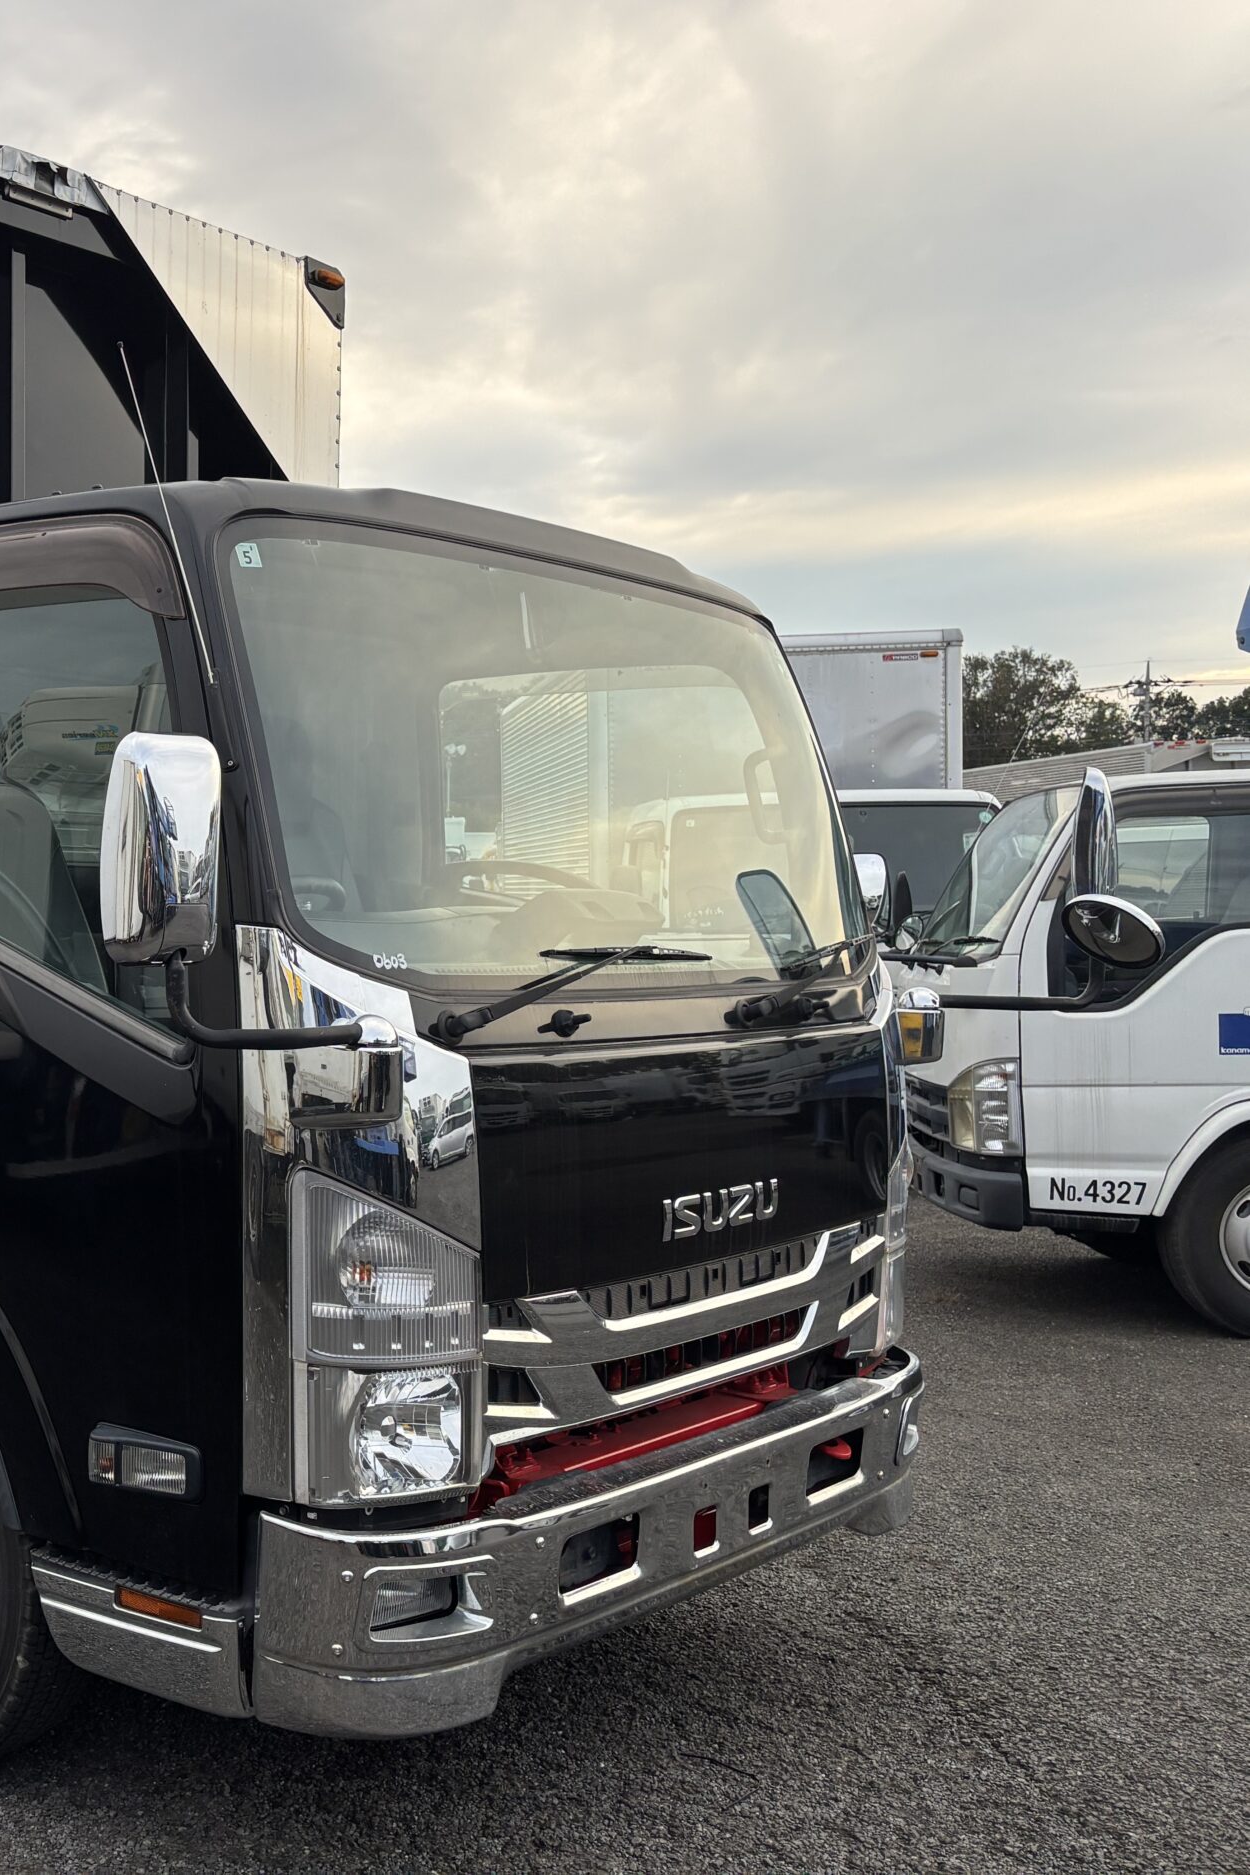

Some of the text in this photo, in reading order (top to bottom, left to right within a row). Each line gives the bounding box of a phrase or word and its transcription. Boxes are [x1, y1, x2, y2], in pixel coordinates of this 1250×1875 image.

[372, 951, 408, 970] 0603
[1049, 1177, 1147, 1206] No.4327
[662, 1178, 779, 1243] ISUZU
